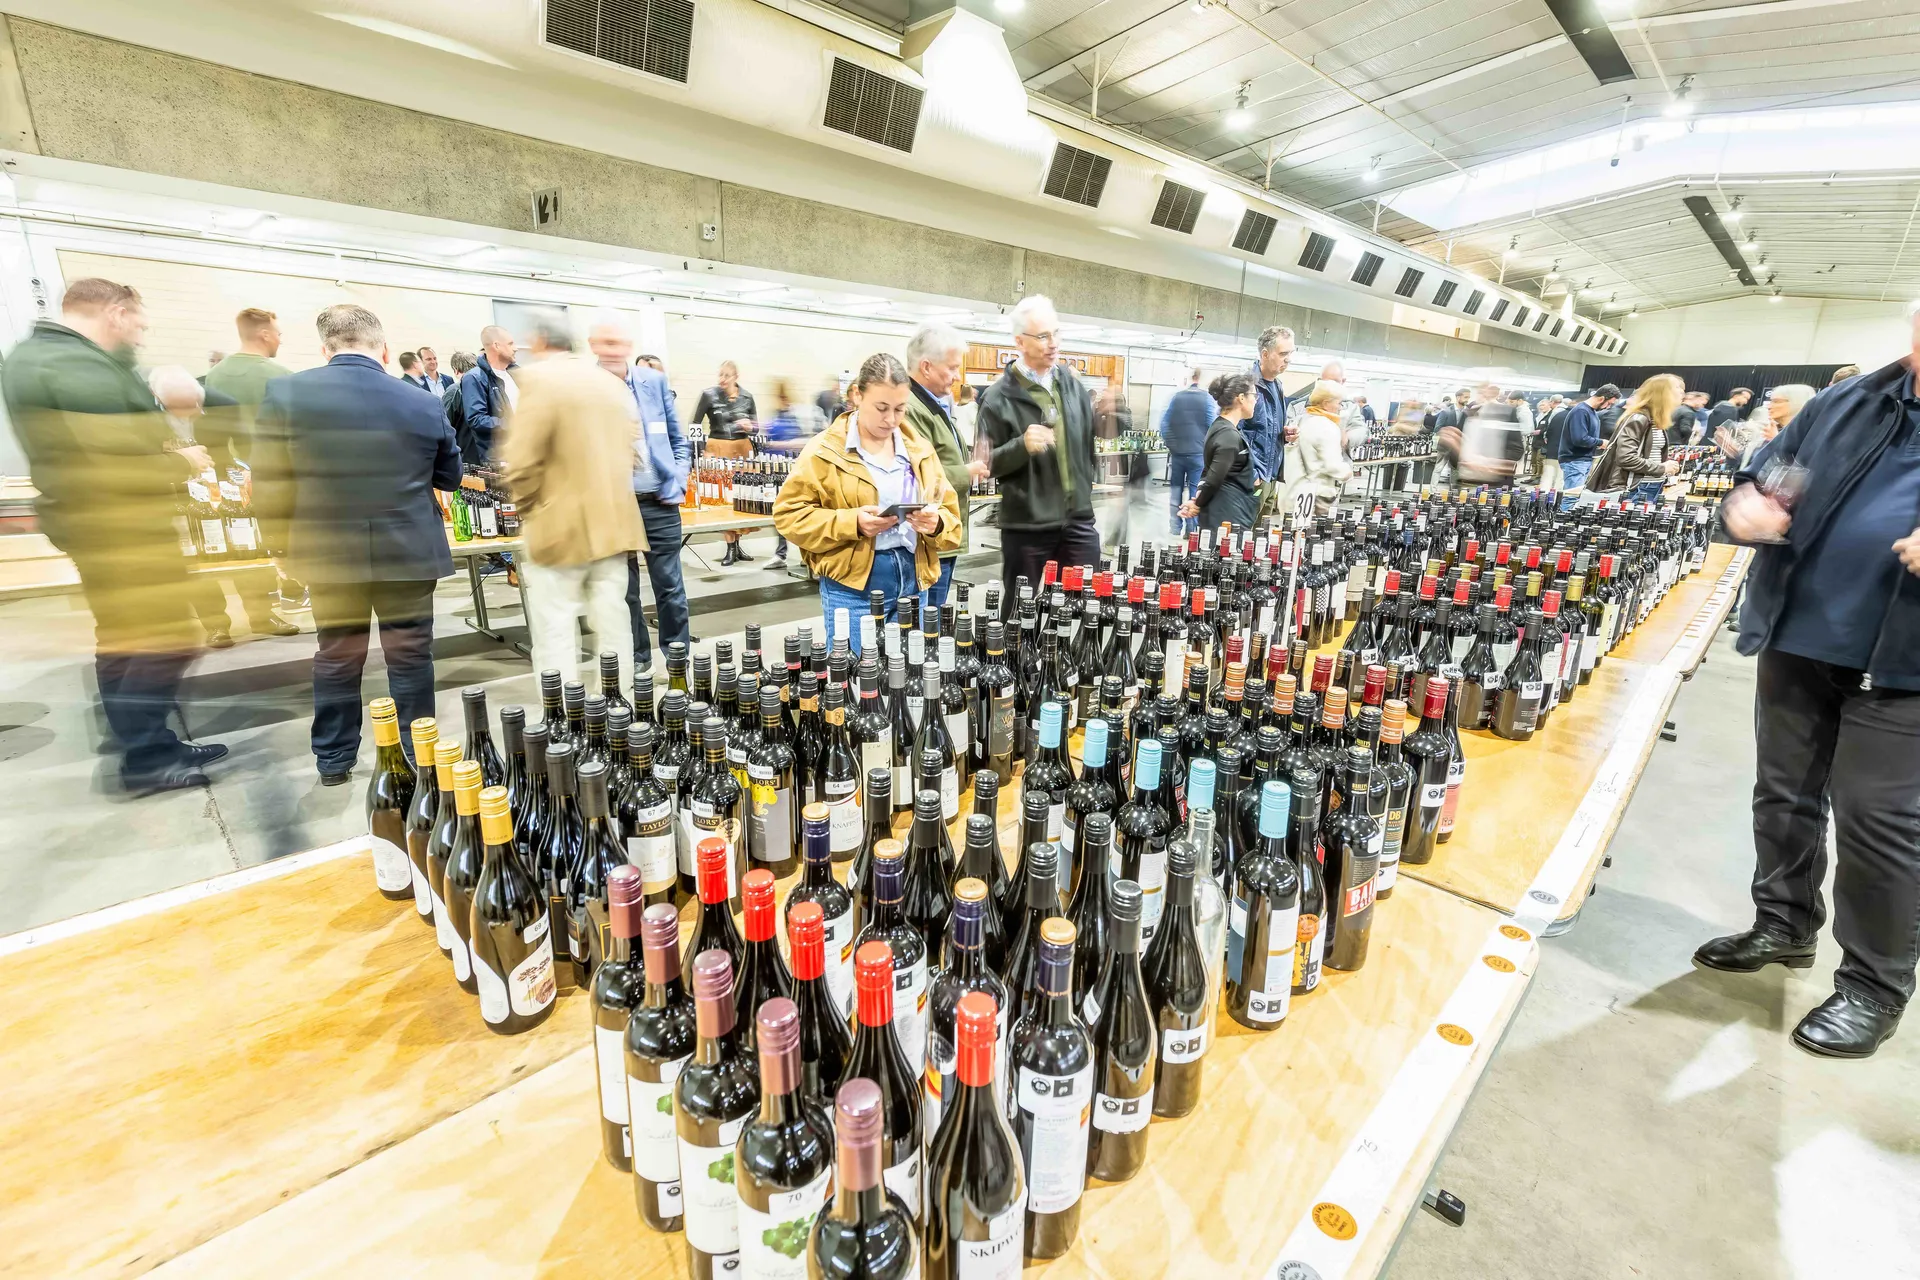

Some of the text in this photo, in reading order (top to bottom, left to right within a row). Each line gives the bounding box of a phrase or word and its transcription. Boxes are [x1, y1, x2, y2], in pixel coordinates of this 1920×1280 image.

[690, 427, 702, 438] 23
[1294, 493, 1313, 519] 30
[1389, 811, 1401, 820] DB
[534, 924, 542, 932] 69
[787, 1192, 802, 1203] 70
